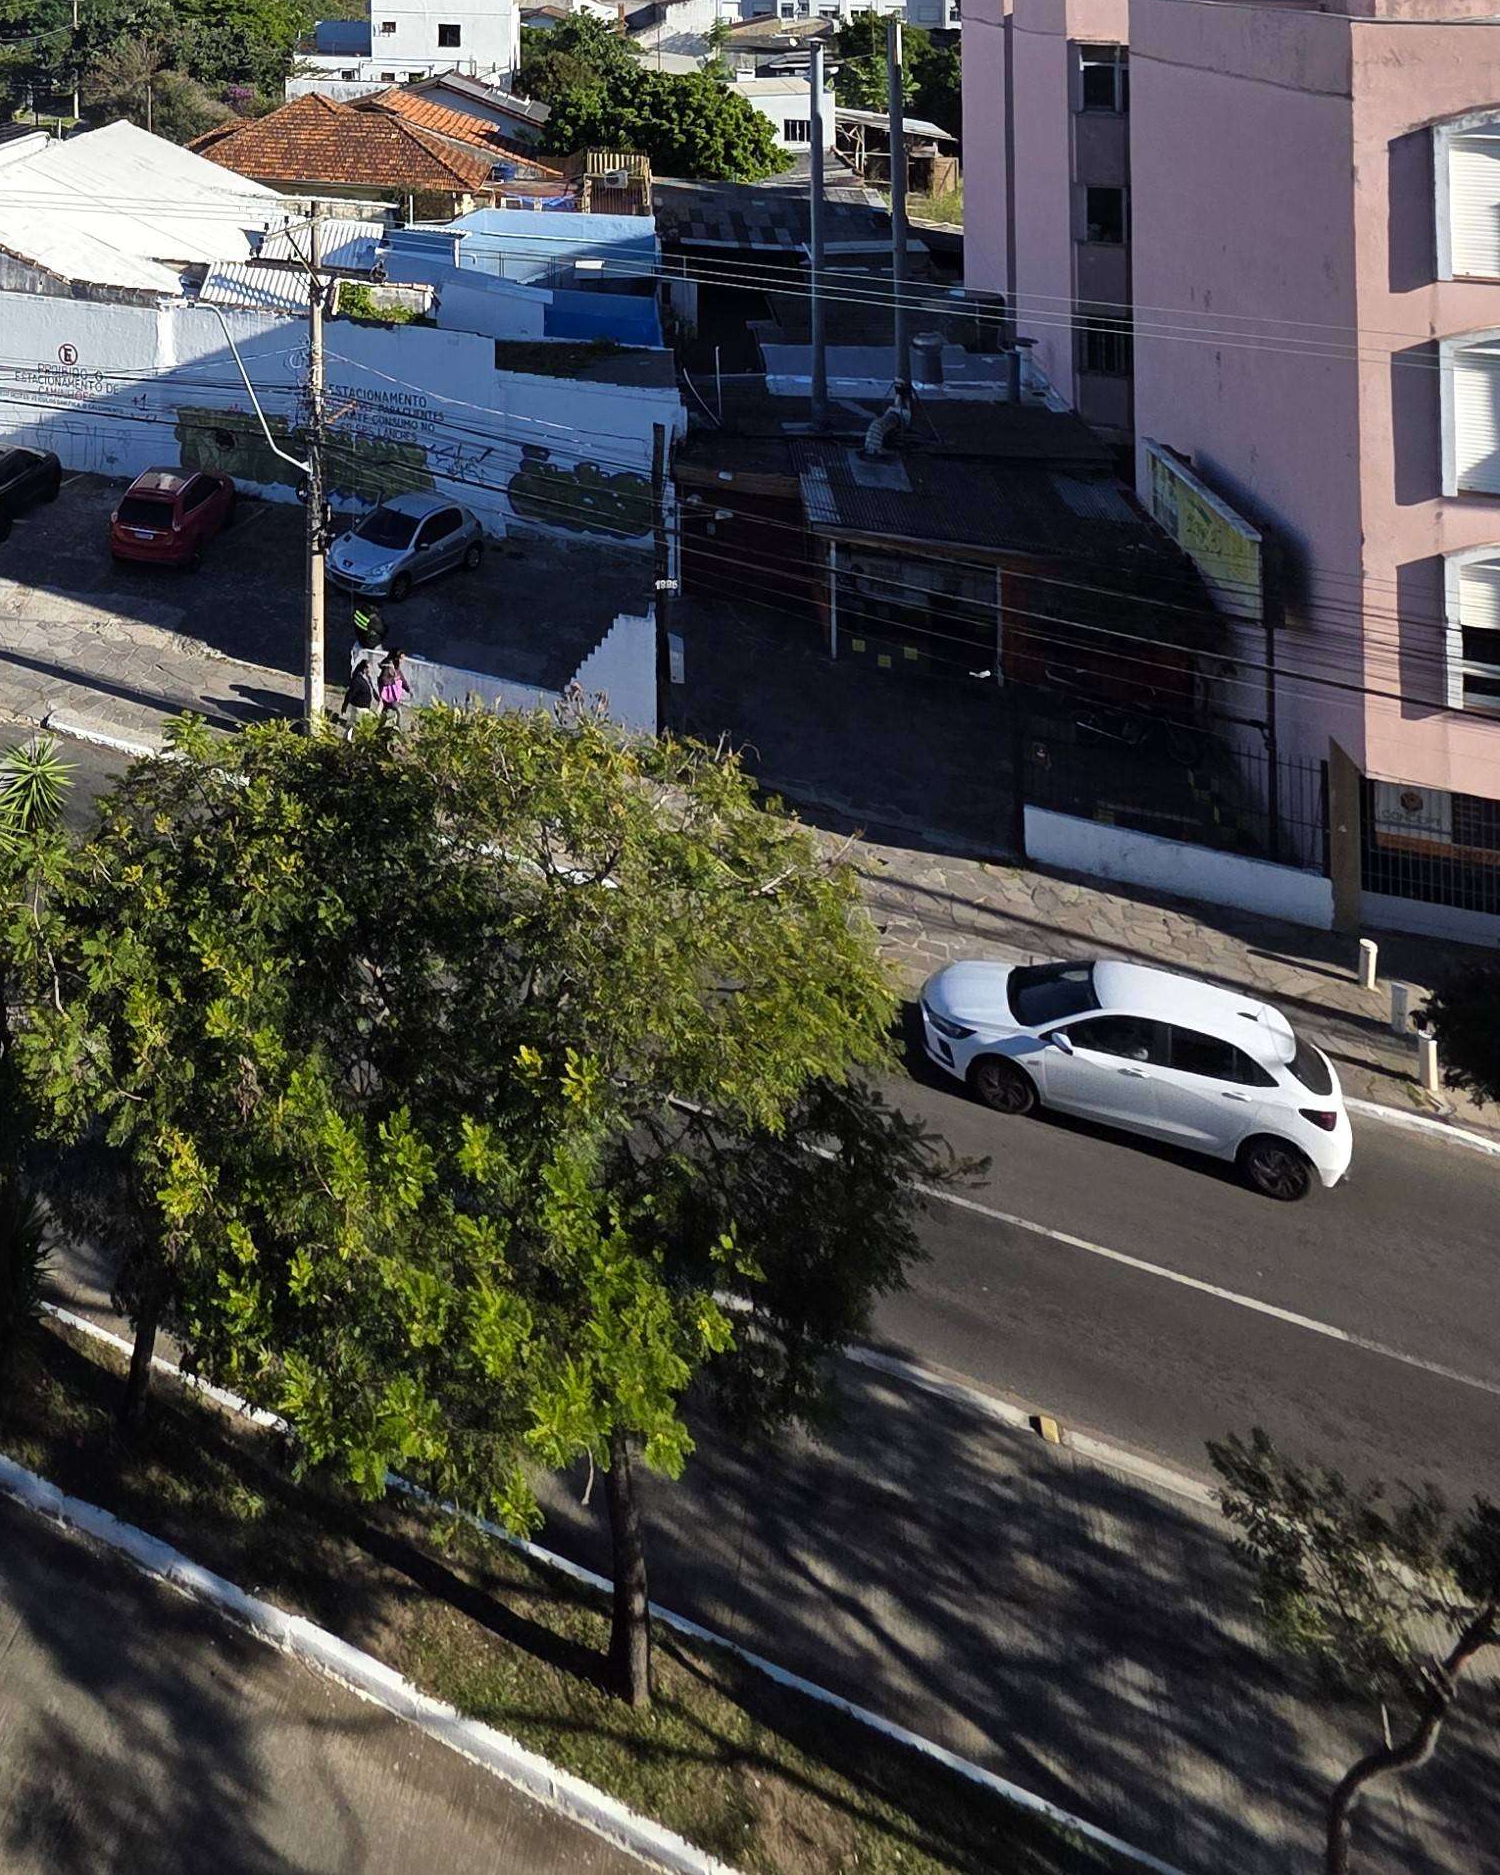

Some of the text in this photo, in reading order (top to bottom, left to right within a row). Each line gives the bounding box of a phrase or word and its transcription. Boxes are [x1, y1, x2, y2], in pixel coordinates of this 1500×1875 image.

[38, 362, 88, 380] PROIBIDO
[15, 370, 120, 396] ESTACIONAMENTO DE
[328, 384, 427, 408] ESTACIONAMENTO
[371, 414, 419, 432] CONSUMO
[421, 420, 436, 433] NO
